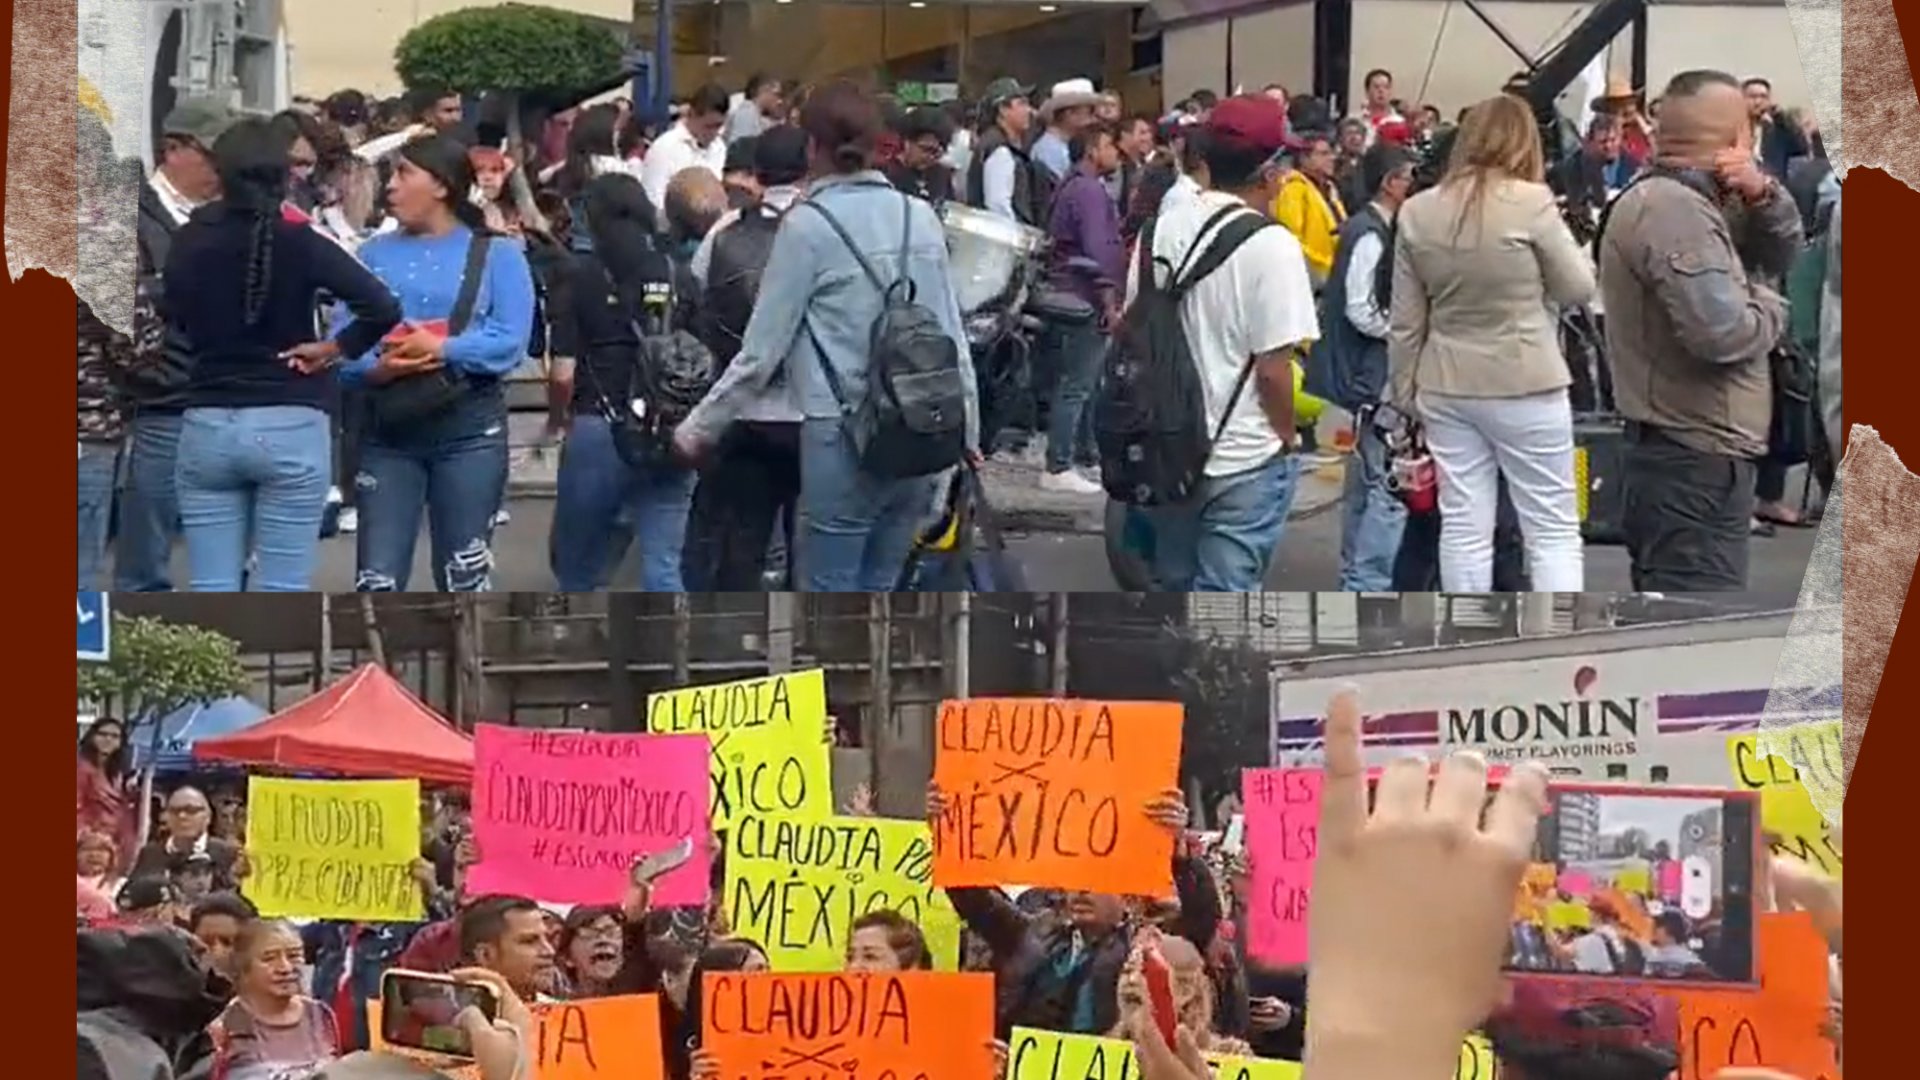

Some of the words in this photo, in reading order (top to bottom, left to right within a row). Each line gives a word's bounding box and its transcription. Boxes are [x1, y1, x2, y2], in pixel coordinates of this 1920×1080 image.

[651, 676, 790, 732] CLAUDIA
[942, 702, 1114, 761] CLAUDIA
[1447, 697, 1641, 745] MONIN
[710, 754, 806, 820] XICO
[737, 815, 881, 872] CLAUDIA
[711, 973, 909, 1045] CLAUDIA
